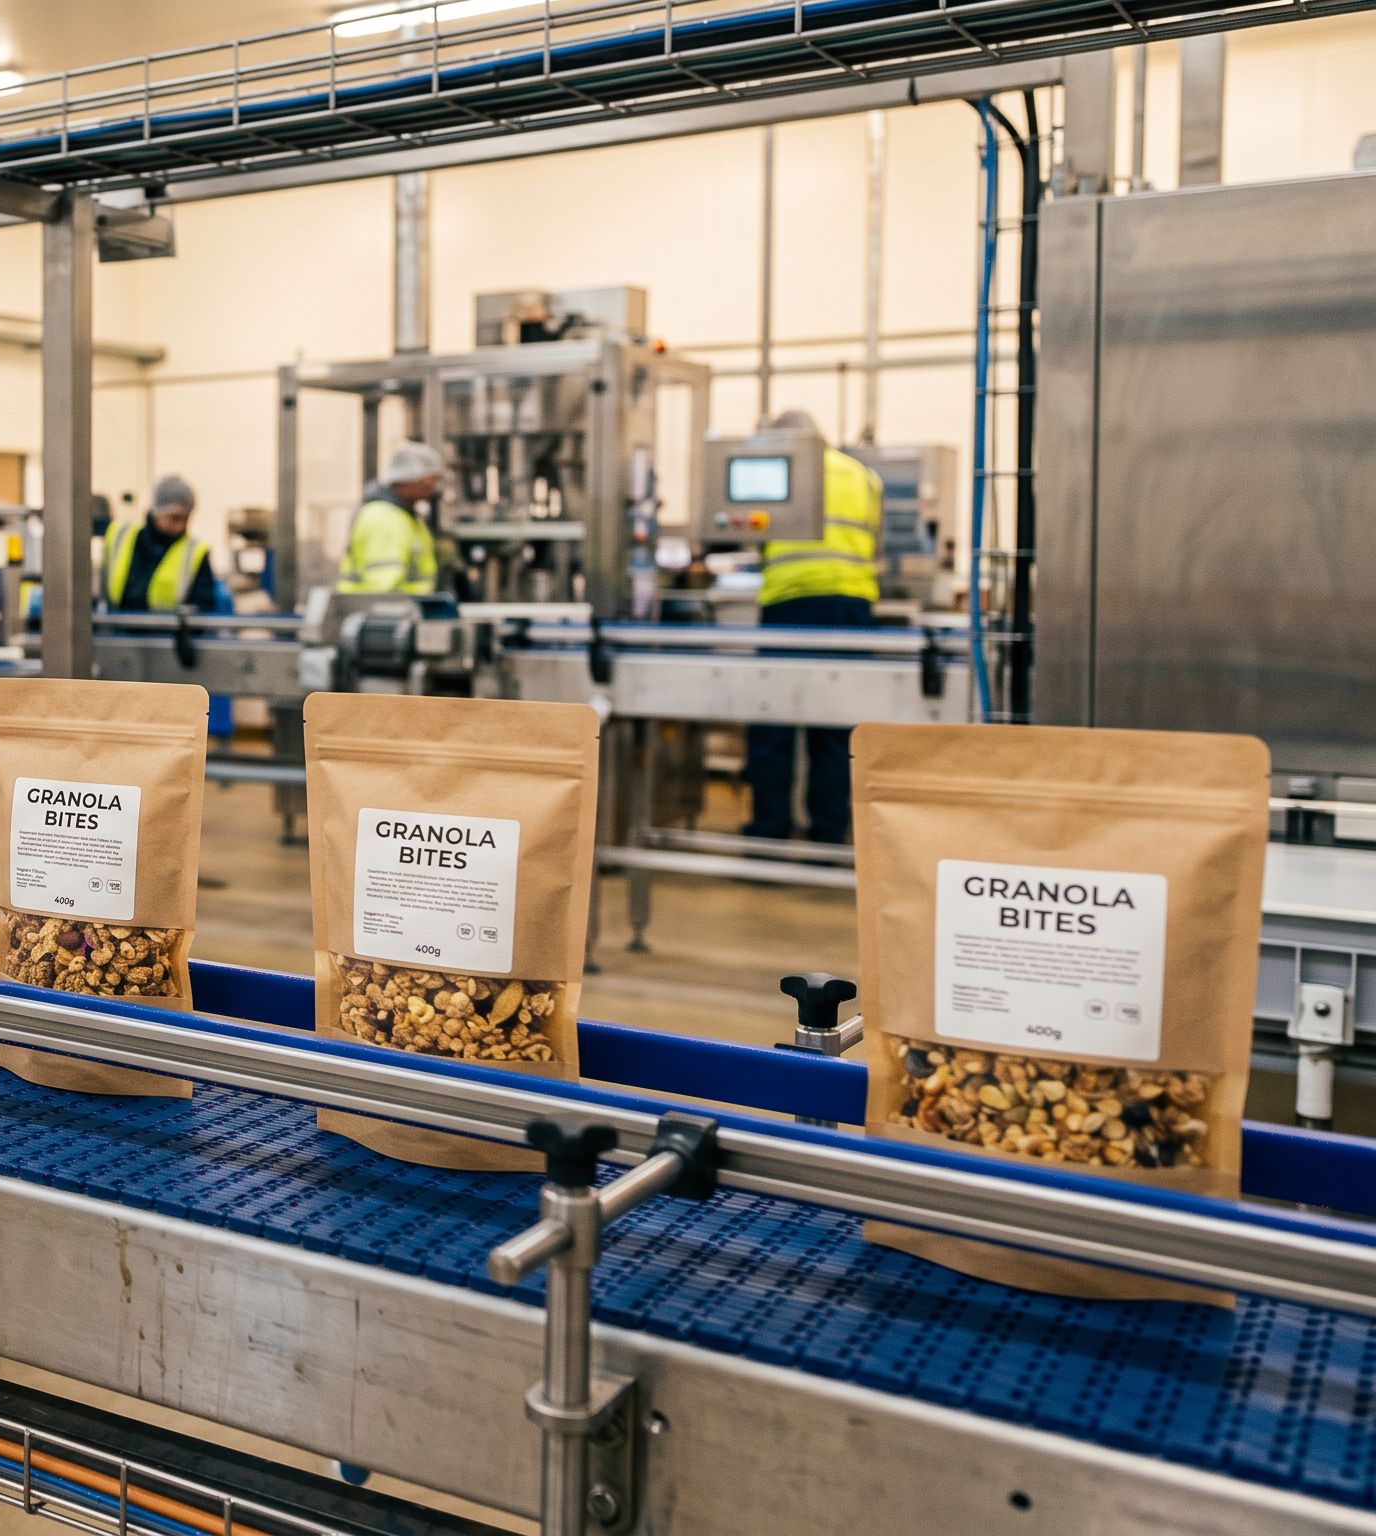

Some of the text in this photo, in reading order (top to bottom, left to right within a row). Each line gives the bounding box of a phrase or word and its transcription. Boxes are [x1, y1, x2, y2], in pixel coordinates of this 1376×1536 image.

[27, 788, 122, 811] GRANOLA
[45, 810, 98, 830] BITES
[376, 821, 496, 848] GRANOLA
[399, 846, 467, 869] BITES
[54, 896, 74, 907] 400g
[964, 876, 1134, 909] GRANOLA
[1000, 907, 1096, 935] BITES
[415, 944, 441, 957] 400g
[1026, 1026, 1062, 1040] 400g
